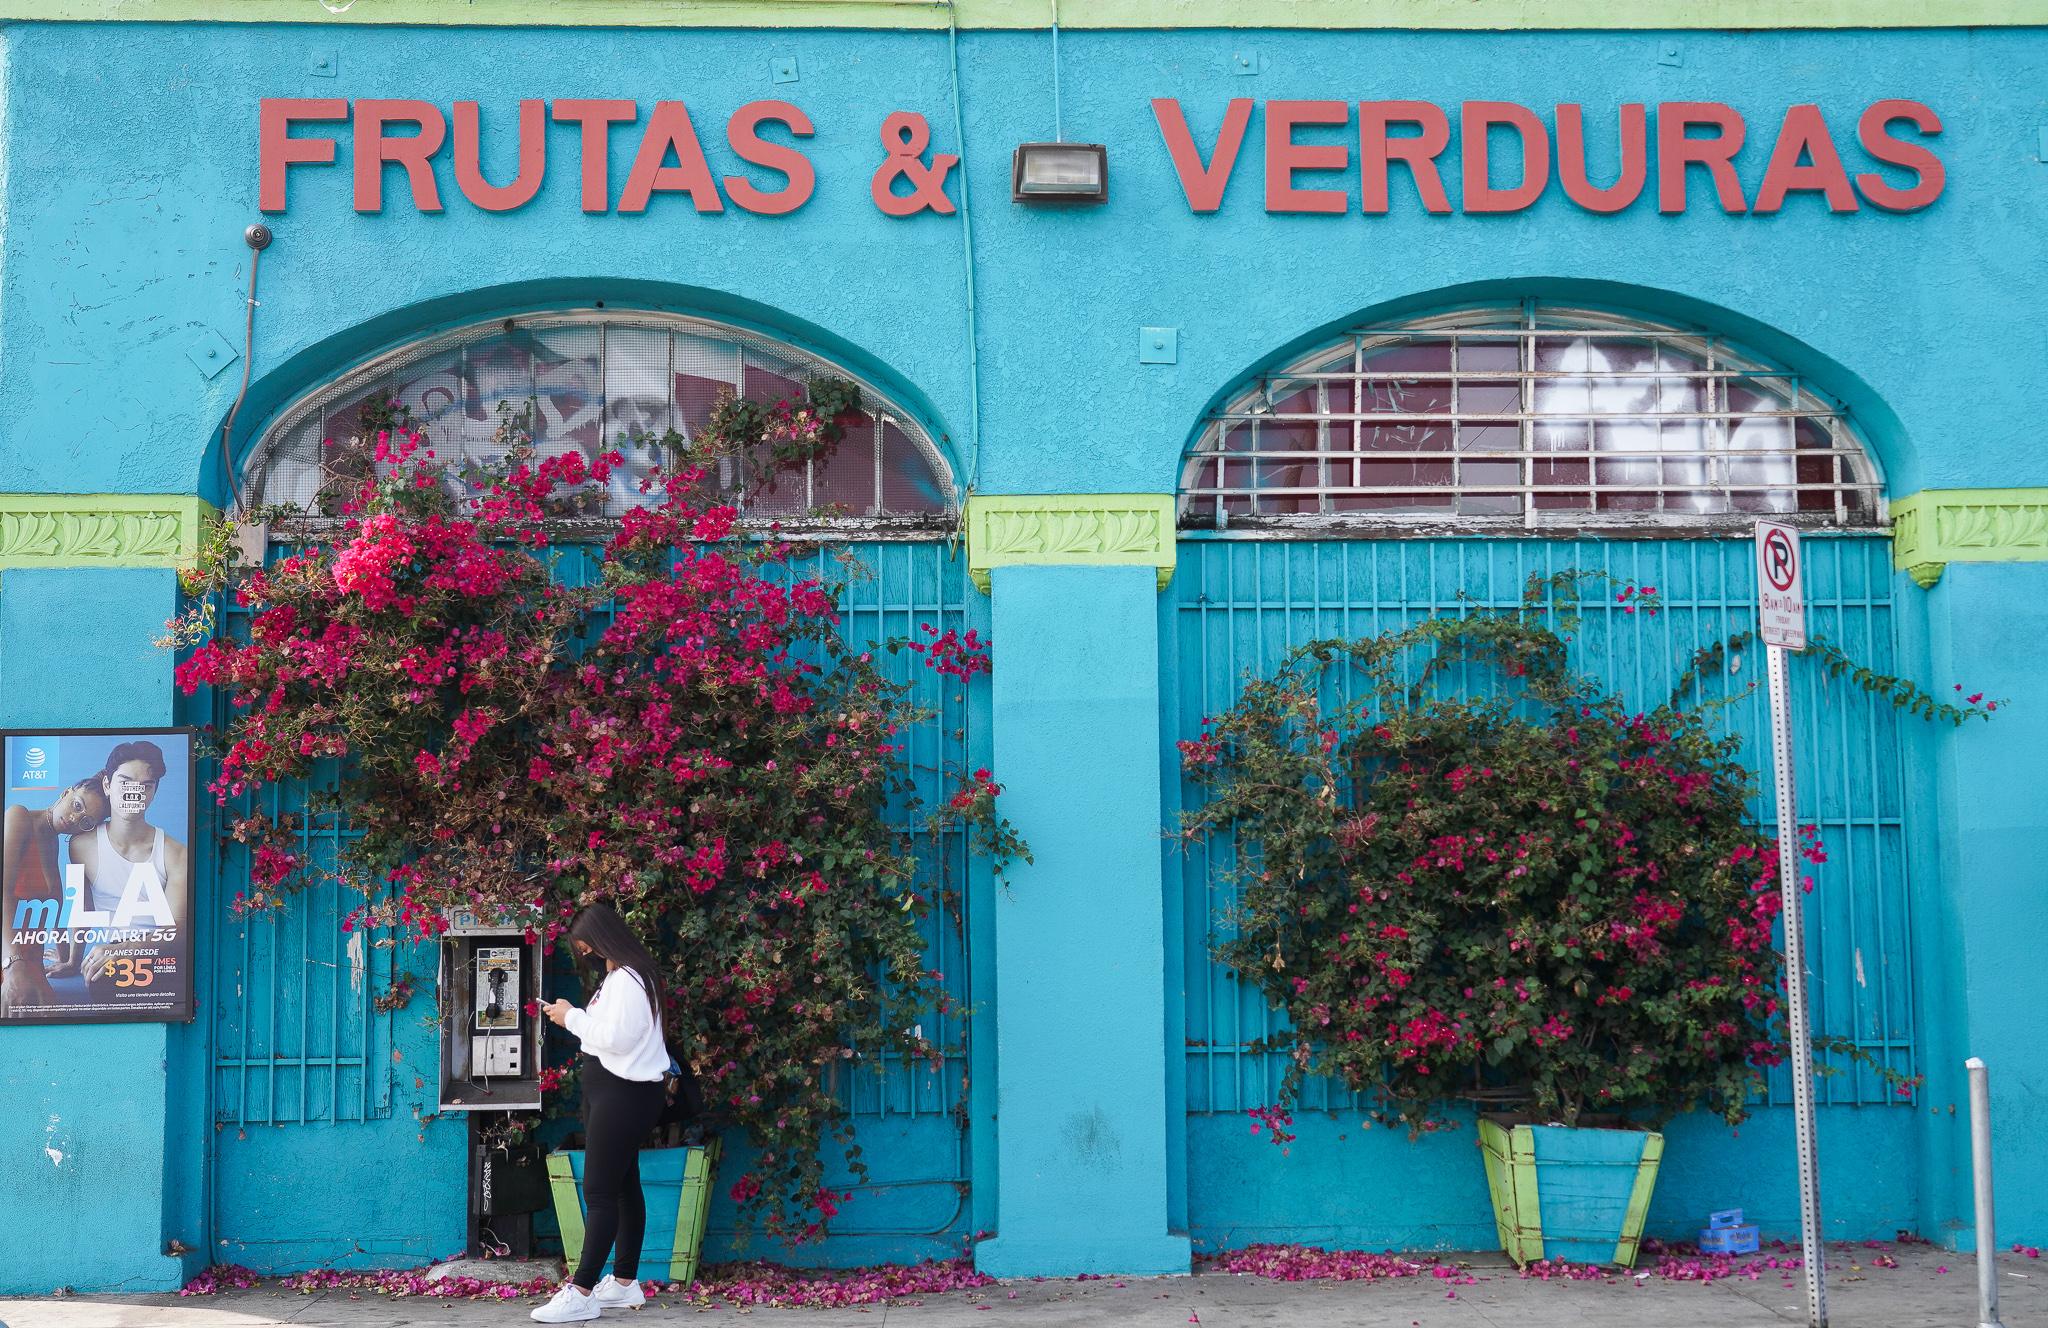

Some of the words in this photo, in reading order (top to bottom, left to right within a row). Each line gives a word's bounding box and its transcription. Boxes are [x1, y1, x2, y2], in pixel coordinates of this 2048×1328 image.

[259, 98, 816, 217] FRUTAS
[871, 111, 961, 217] &
[1150, 97, 1947, 215] VERDURAS
[22, 770, 48, 780] AT&T
[11, 930, 70, 945] AHORA
[74, 929, 110, 943] CON
[110, 928, 149, 943] AT&T
[150, 928, 177, 942] 5G
[104, 958, 153, 987] $35
